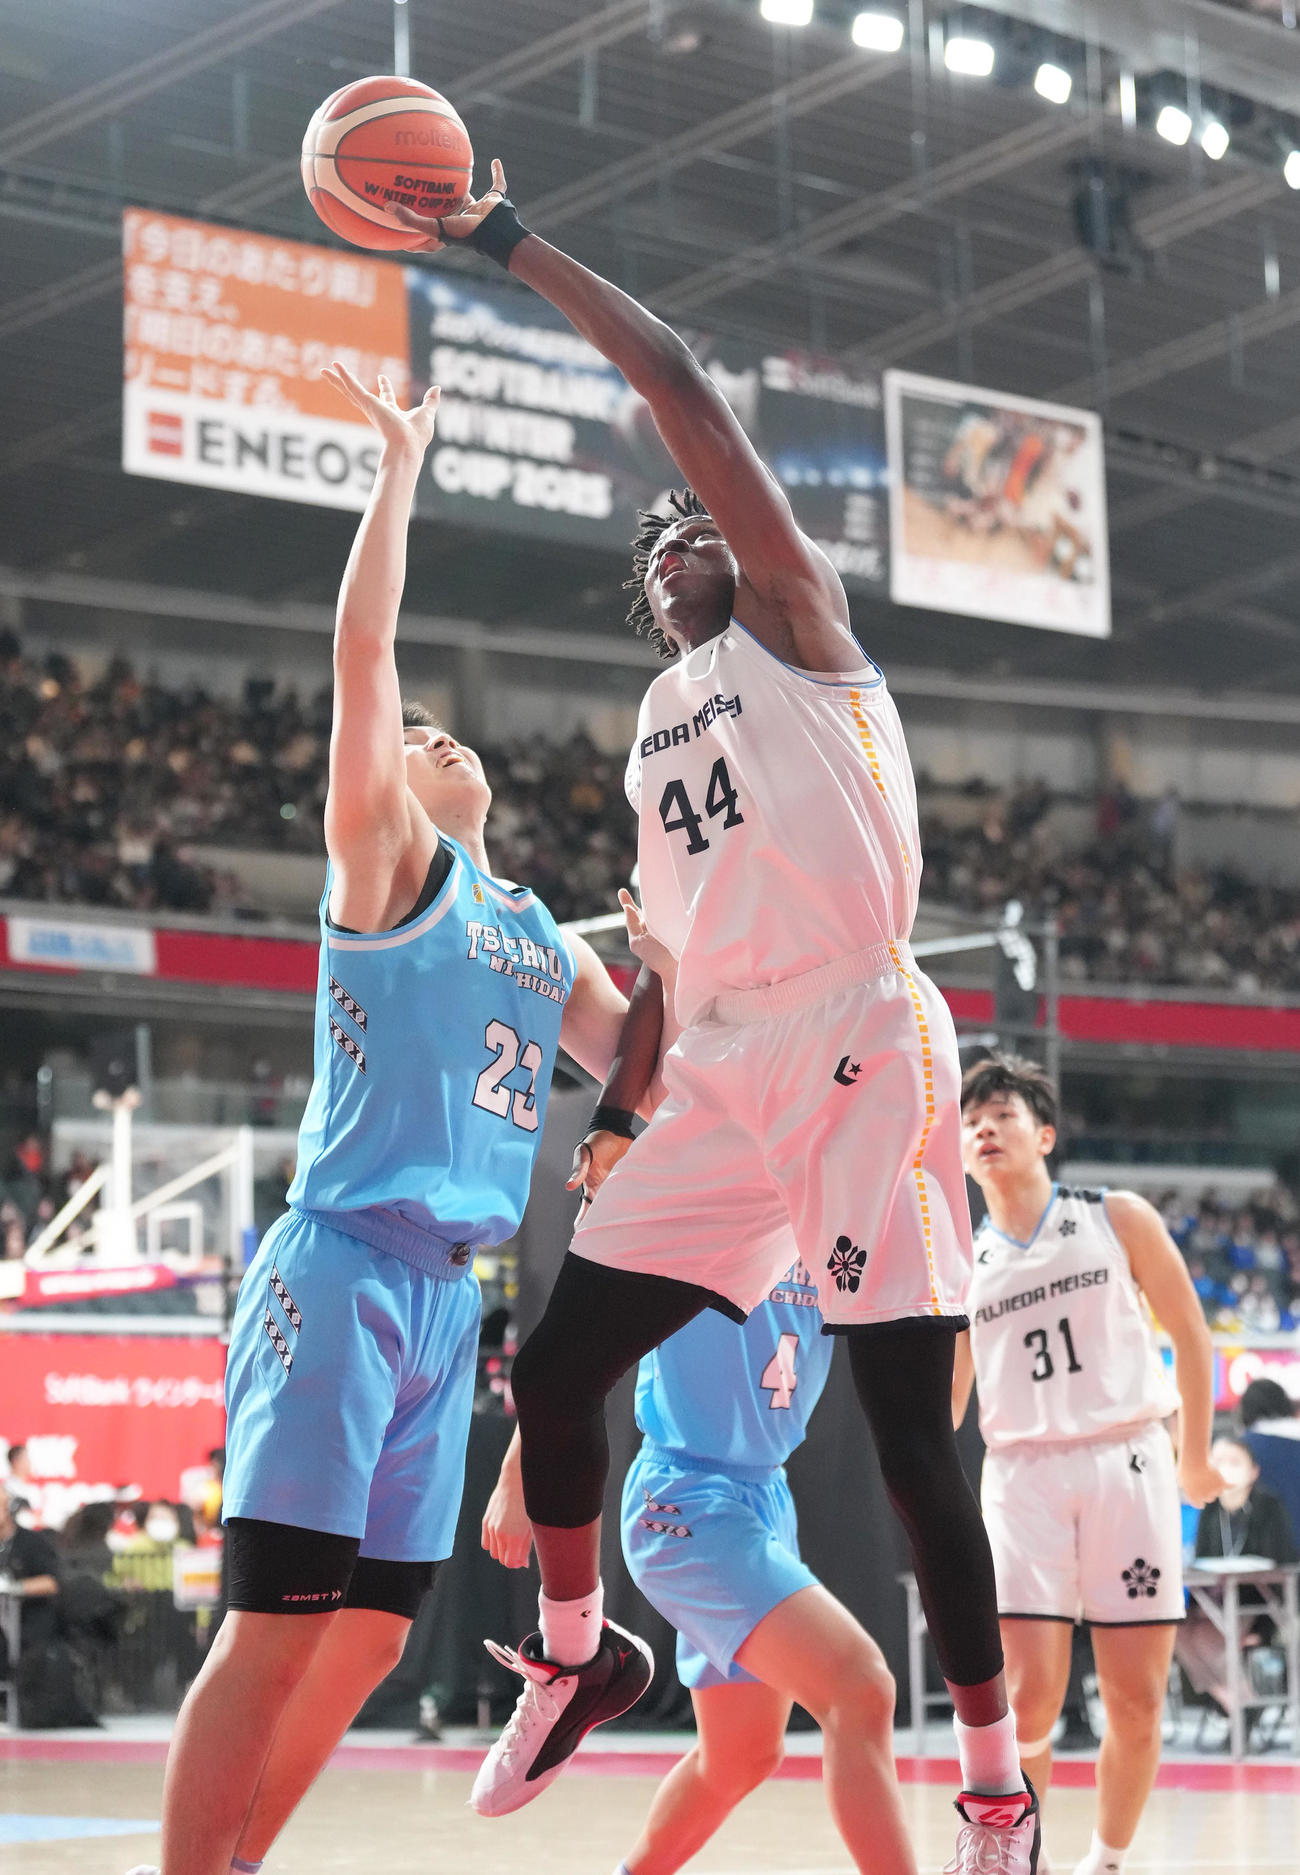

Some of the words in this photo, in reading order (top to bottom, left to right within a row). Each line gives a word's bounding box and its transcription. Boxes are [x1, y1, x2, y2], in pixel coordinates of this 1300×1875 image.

[364, 181, 417, 207] WINTER
[418, 196, 443, 210] CUP
[394, 174, 457, 195] SOFTBANK
[196, 419, 379, 494] ENEOS
[432, 446, 512, 500] CUP
[659, 757, 744, 856] 44
[489, 954, 565, 1005] NIHIDAI
[472, 1018, 543, 1133] 23
[975, 1286, 1046, 1327] FUJIEDA
[1049, 1268, 1108, 1298] MEISEI
[760, 1332, 799, 1410] 4
[1024, 1317, 1082, 1382] 31
